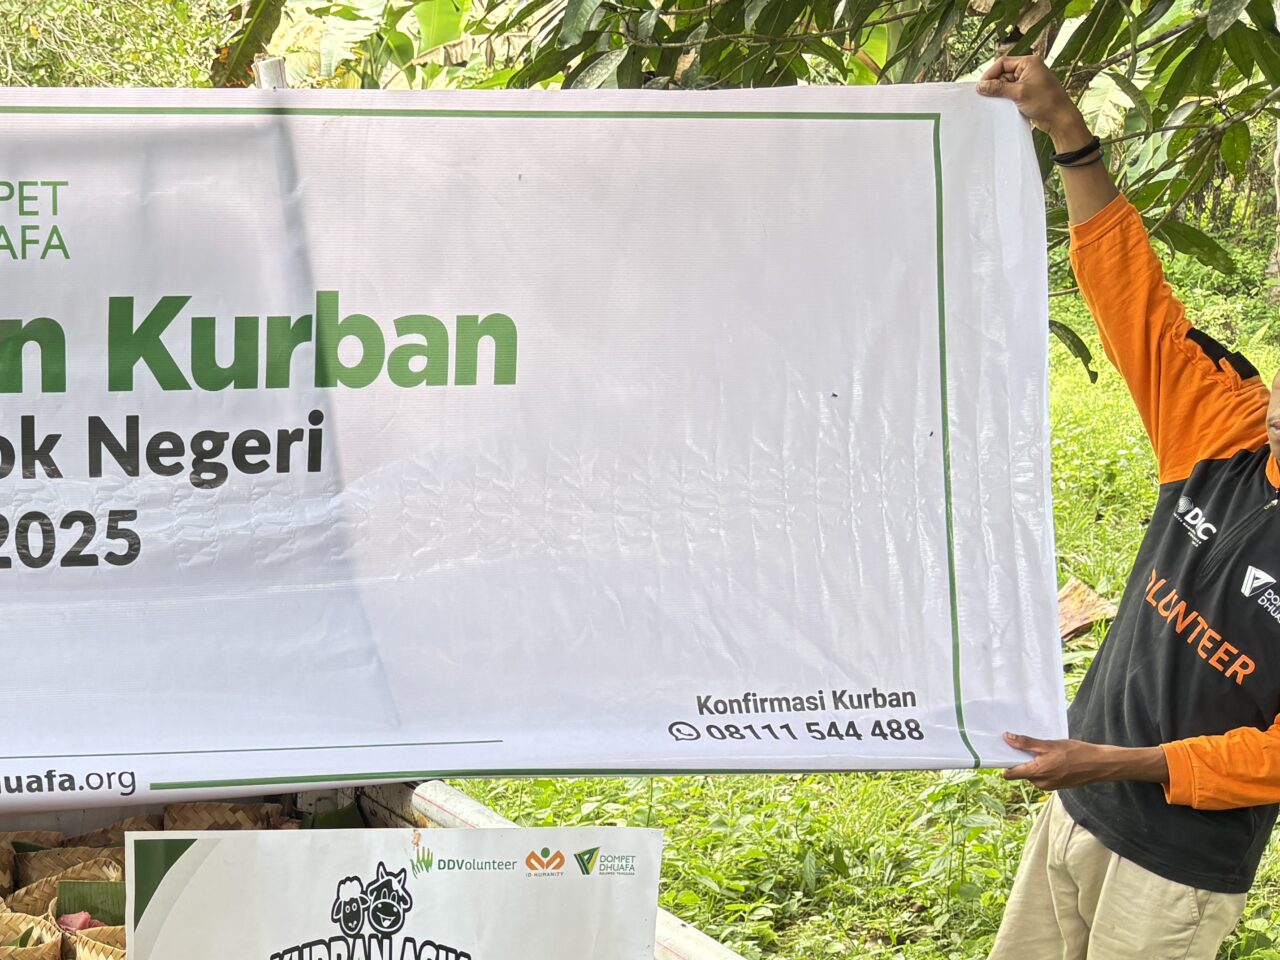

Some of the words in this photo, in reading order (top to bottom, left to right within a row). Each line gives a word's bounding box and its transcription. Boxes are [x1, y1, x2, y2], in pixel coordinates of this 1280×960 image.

[107, 291, 519, 392] Kurban
[88, 409, 325, 490] Negeri
[696, 689, 825, 716] Konfirmasi
[832, 688, 917, 711] Kurban
[706, 723, 798, 741] 08111
[806, 720, 862, 741] 544
[870, 718, 924, 741] 488
[437, 858, 517, 870] DDVolunteer
[600, 855, 636, 863] DOMPET
